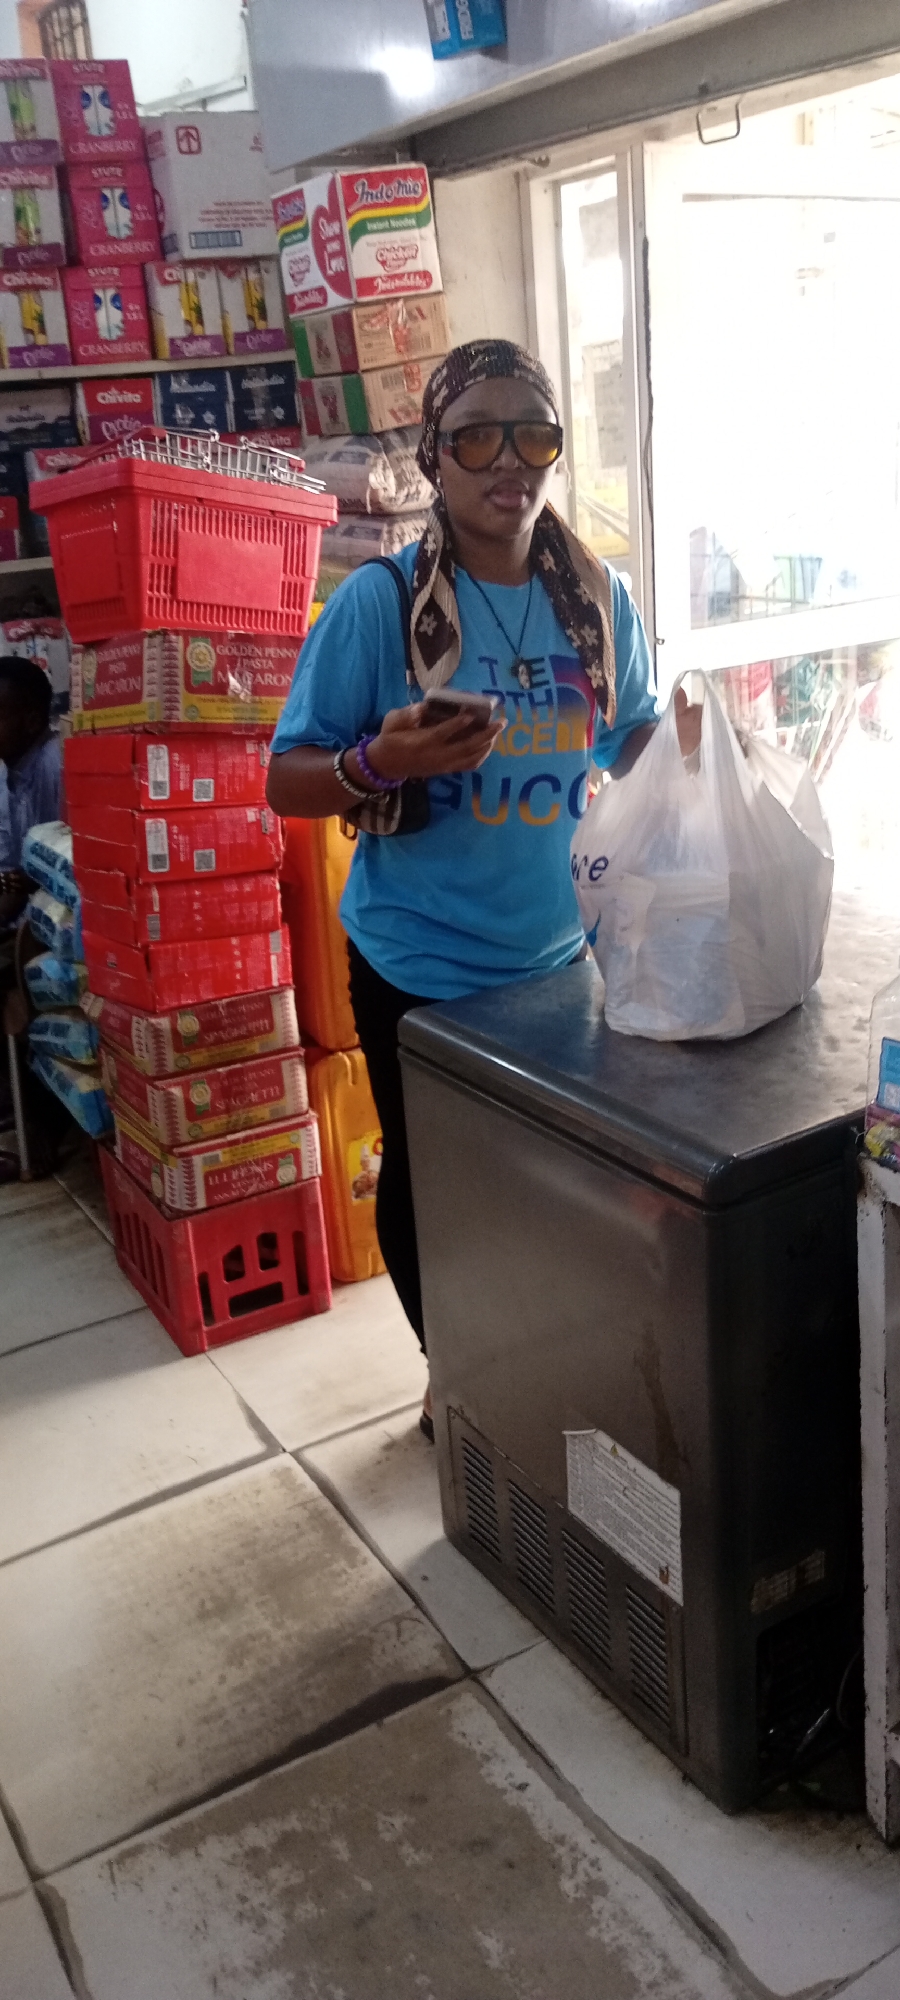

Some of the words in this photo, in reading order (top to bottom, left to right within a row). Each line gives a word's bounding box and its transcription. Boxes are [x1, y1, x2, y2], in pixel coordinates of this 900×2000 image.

[69, 140, 137, 155] CRANBERRY
[89, 240, 155, 257] CRANBERRY
[87, 267, 121, 278] STUTE
[79, 341, 149, 357] CRANBERRY
[97, 387, 141, 405] Chivita
[216, 644, 263, 658] GOLDEN
[264, 647, 299, 659] PENNY
[242, 658, 275, 670] PASTA
[477, 656, 551, 688] TE
[491, 722, 553, 757] ACE
